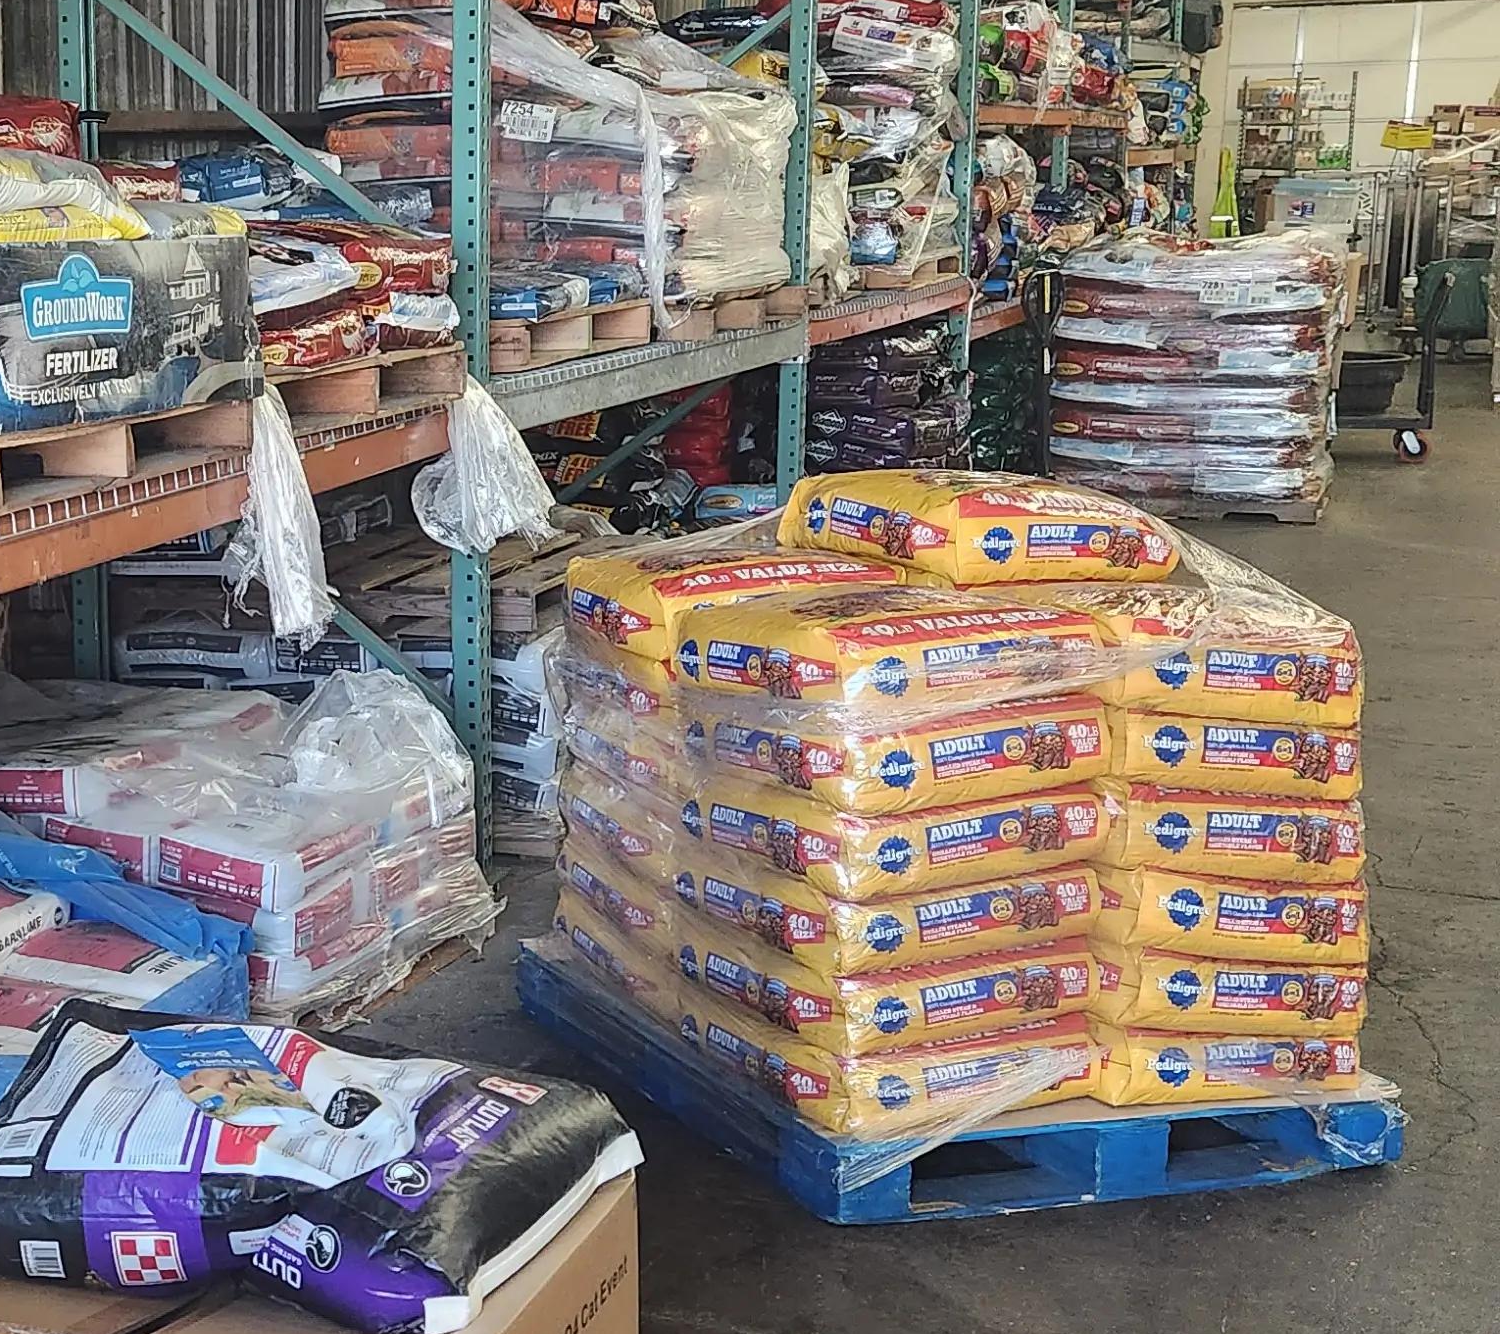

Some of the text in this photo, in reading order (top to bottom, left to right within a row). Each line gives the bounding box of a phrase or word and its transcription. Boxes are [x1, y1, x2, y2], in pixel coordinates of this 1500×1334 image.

[503, 101, 534, 115] 7254
[1202, 281, 1225, 290] 7281
[32, 291, 126, 327] GROUNDWORK
[44, 348, 118, 378] FERTILIZER
[30, 383, 113, 407] EXCLUSIVELY AT
[853, 415, 876, 423] PUPPY
[832, 499, 866, 518] ADULT
[1030, 525, 1078, 539] ADULT
[732, 563, 810, 581] VALUE
[914, 614, 999, 631] VALUE
[709, 643, 742, 660] ADULT
[926, 644, 981, 664] ADULT
[1208, 652, 1258, 666] ADULT
[933, 734, 986, 756] ADULT
[1067, 724, 1099, 737] 40LB
[1071, 737, 1098, 747] VALUE
[1206, 729, 1259, 743] ADULT
[712, 806, 745, 825] ADULT
[929, 820, 983, 842] ADULT
[1064, 806, 1097, 821] 40LB
[1068, 819, 1094, 829] VALUE
[1144, 814, 1262, 838] Pedigree ADULT
[706, 878, 736, 902] ADULT
[918, 883, 1088, 921] ADULT 40LB
[1060, 895, 1087, 906] VALUE
[1157, 895, 1268, 916] Pedigree ADULT
[707, 954, 740, 979] ADULT
[924, 980, 977, 1002] ADULT
[1060, 967, 1088, 980] 40LB
[1062, 980, 1087, 989] VALUE
[1216, 975, 1268, 988] ADULT
[707, 1026, 740, 1052] ADULT
[1208, 1045, 1255, 1060] ADULT
[925, 1063, 979, 1083] ADULT
[446, 1101, 511, 1152] OUTLAST
[581, 1291, 598, 1328] Cat
[600, 1255, 627, 1306] Event
